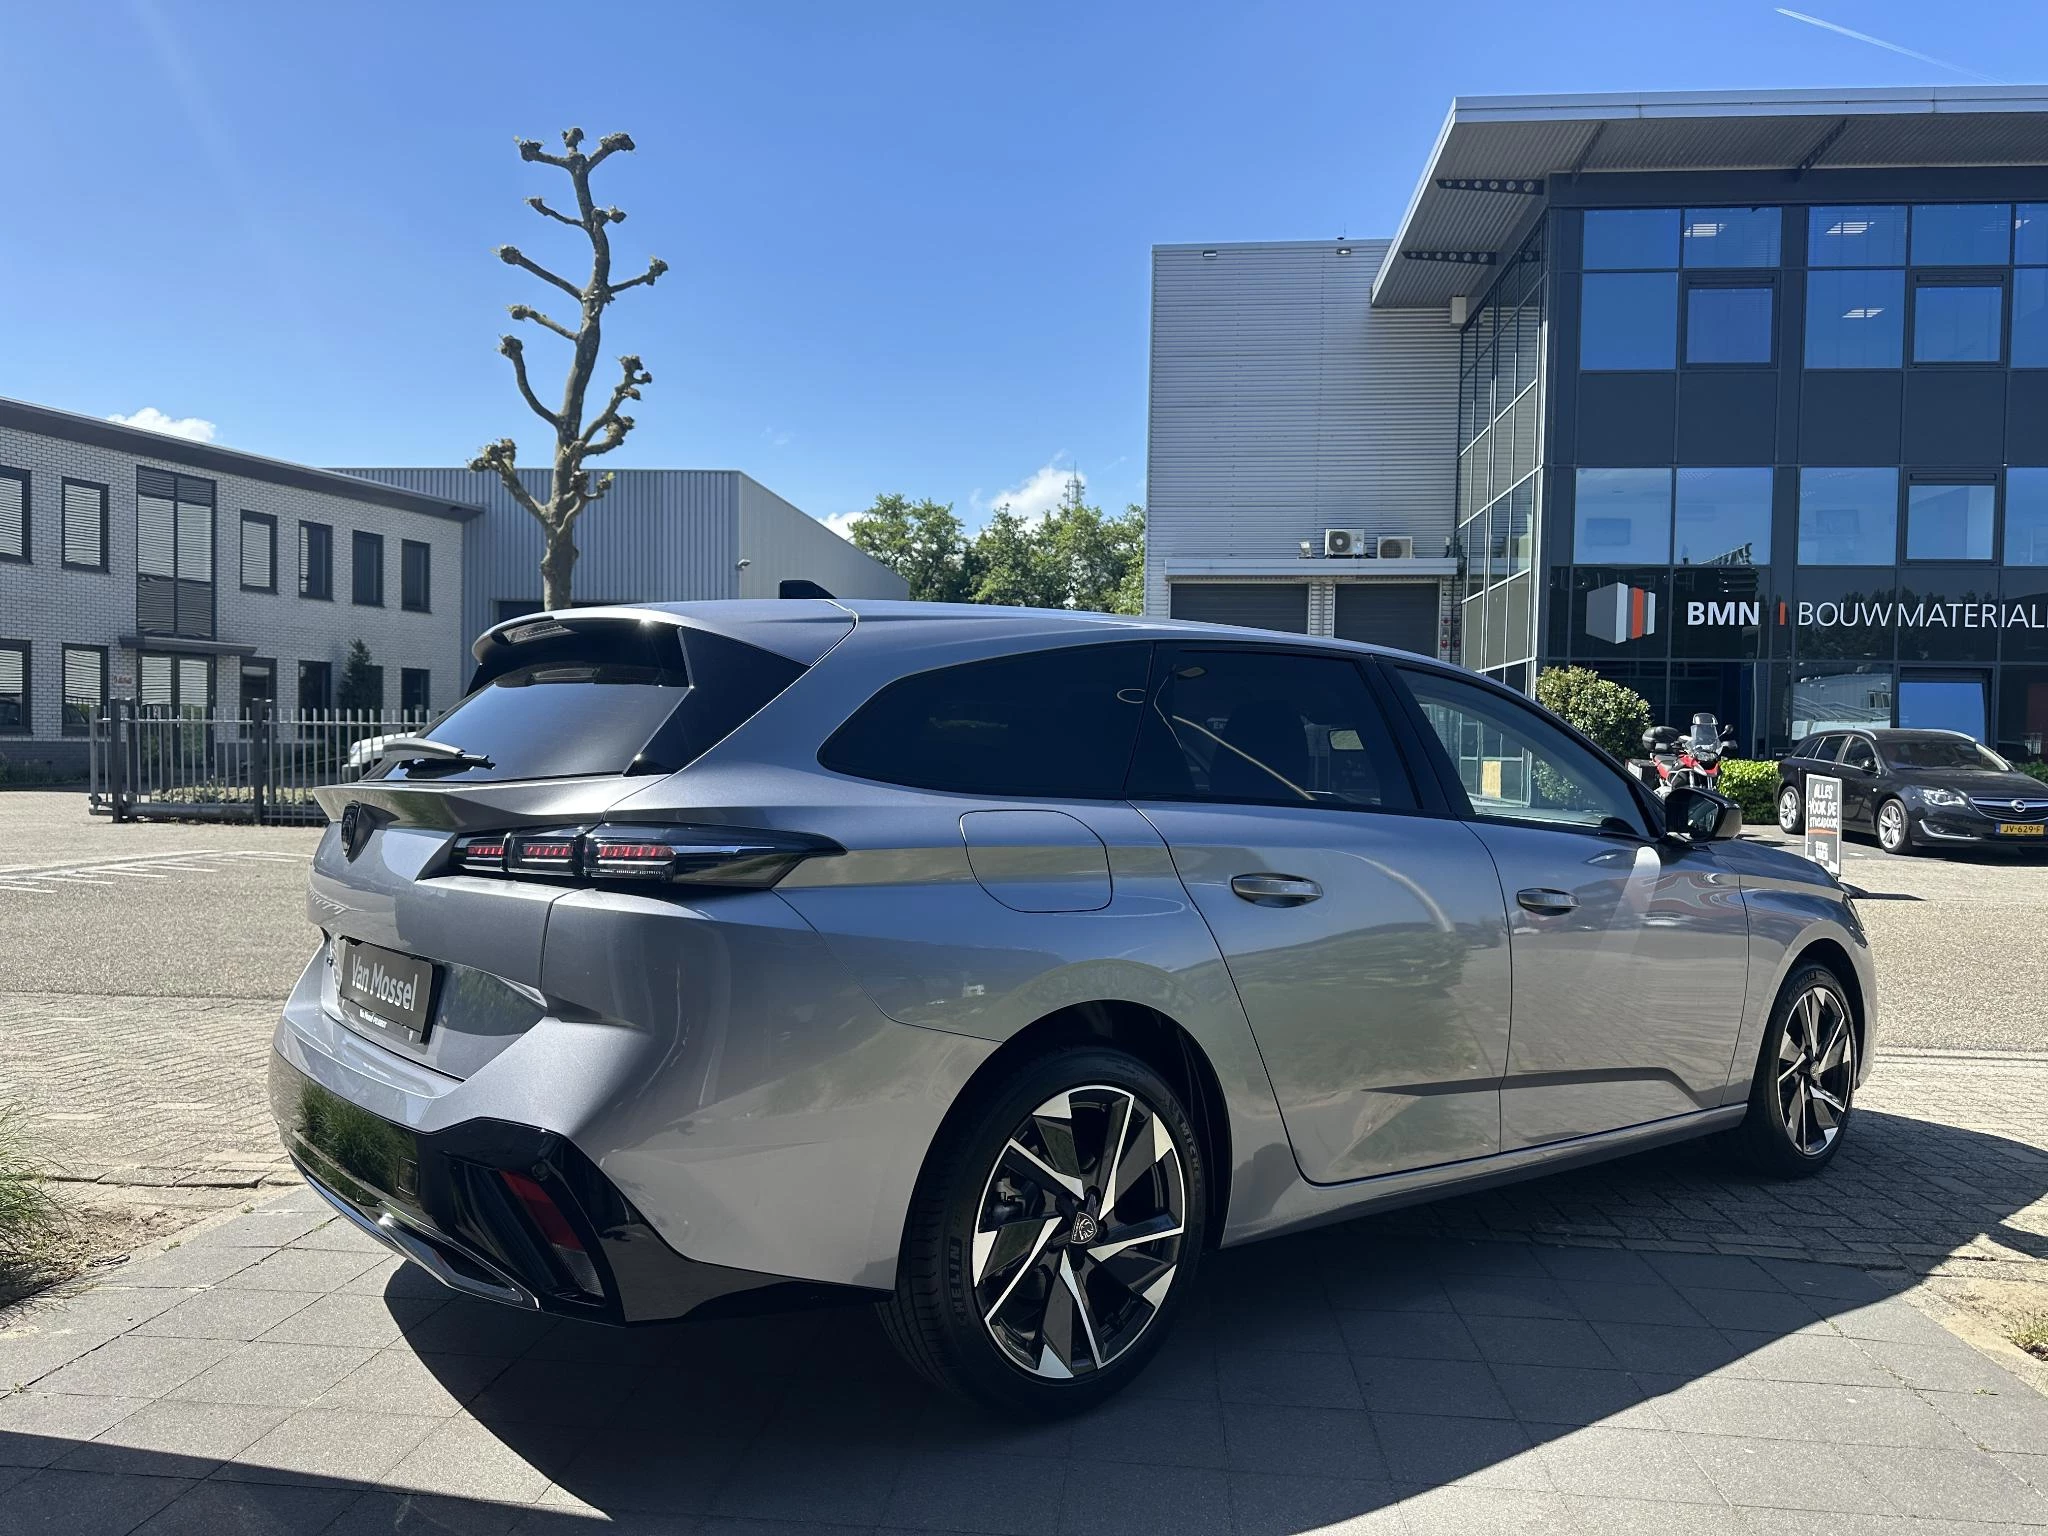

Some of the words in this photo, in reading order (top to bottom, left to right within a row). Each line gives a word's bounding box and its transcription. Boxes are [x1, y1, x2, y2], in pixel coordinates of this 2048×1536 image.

[1687, 601, 1760, 626] BMN
[1797, 602, 2048, 628] BOUWMATERIAL
[1813, 783, 1834, 800] ALLES
[1827, 801, 1838, 817] DE
[351, 953, 370, 993] Van
[369, 962, 418, 1012] Mossel
